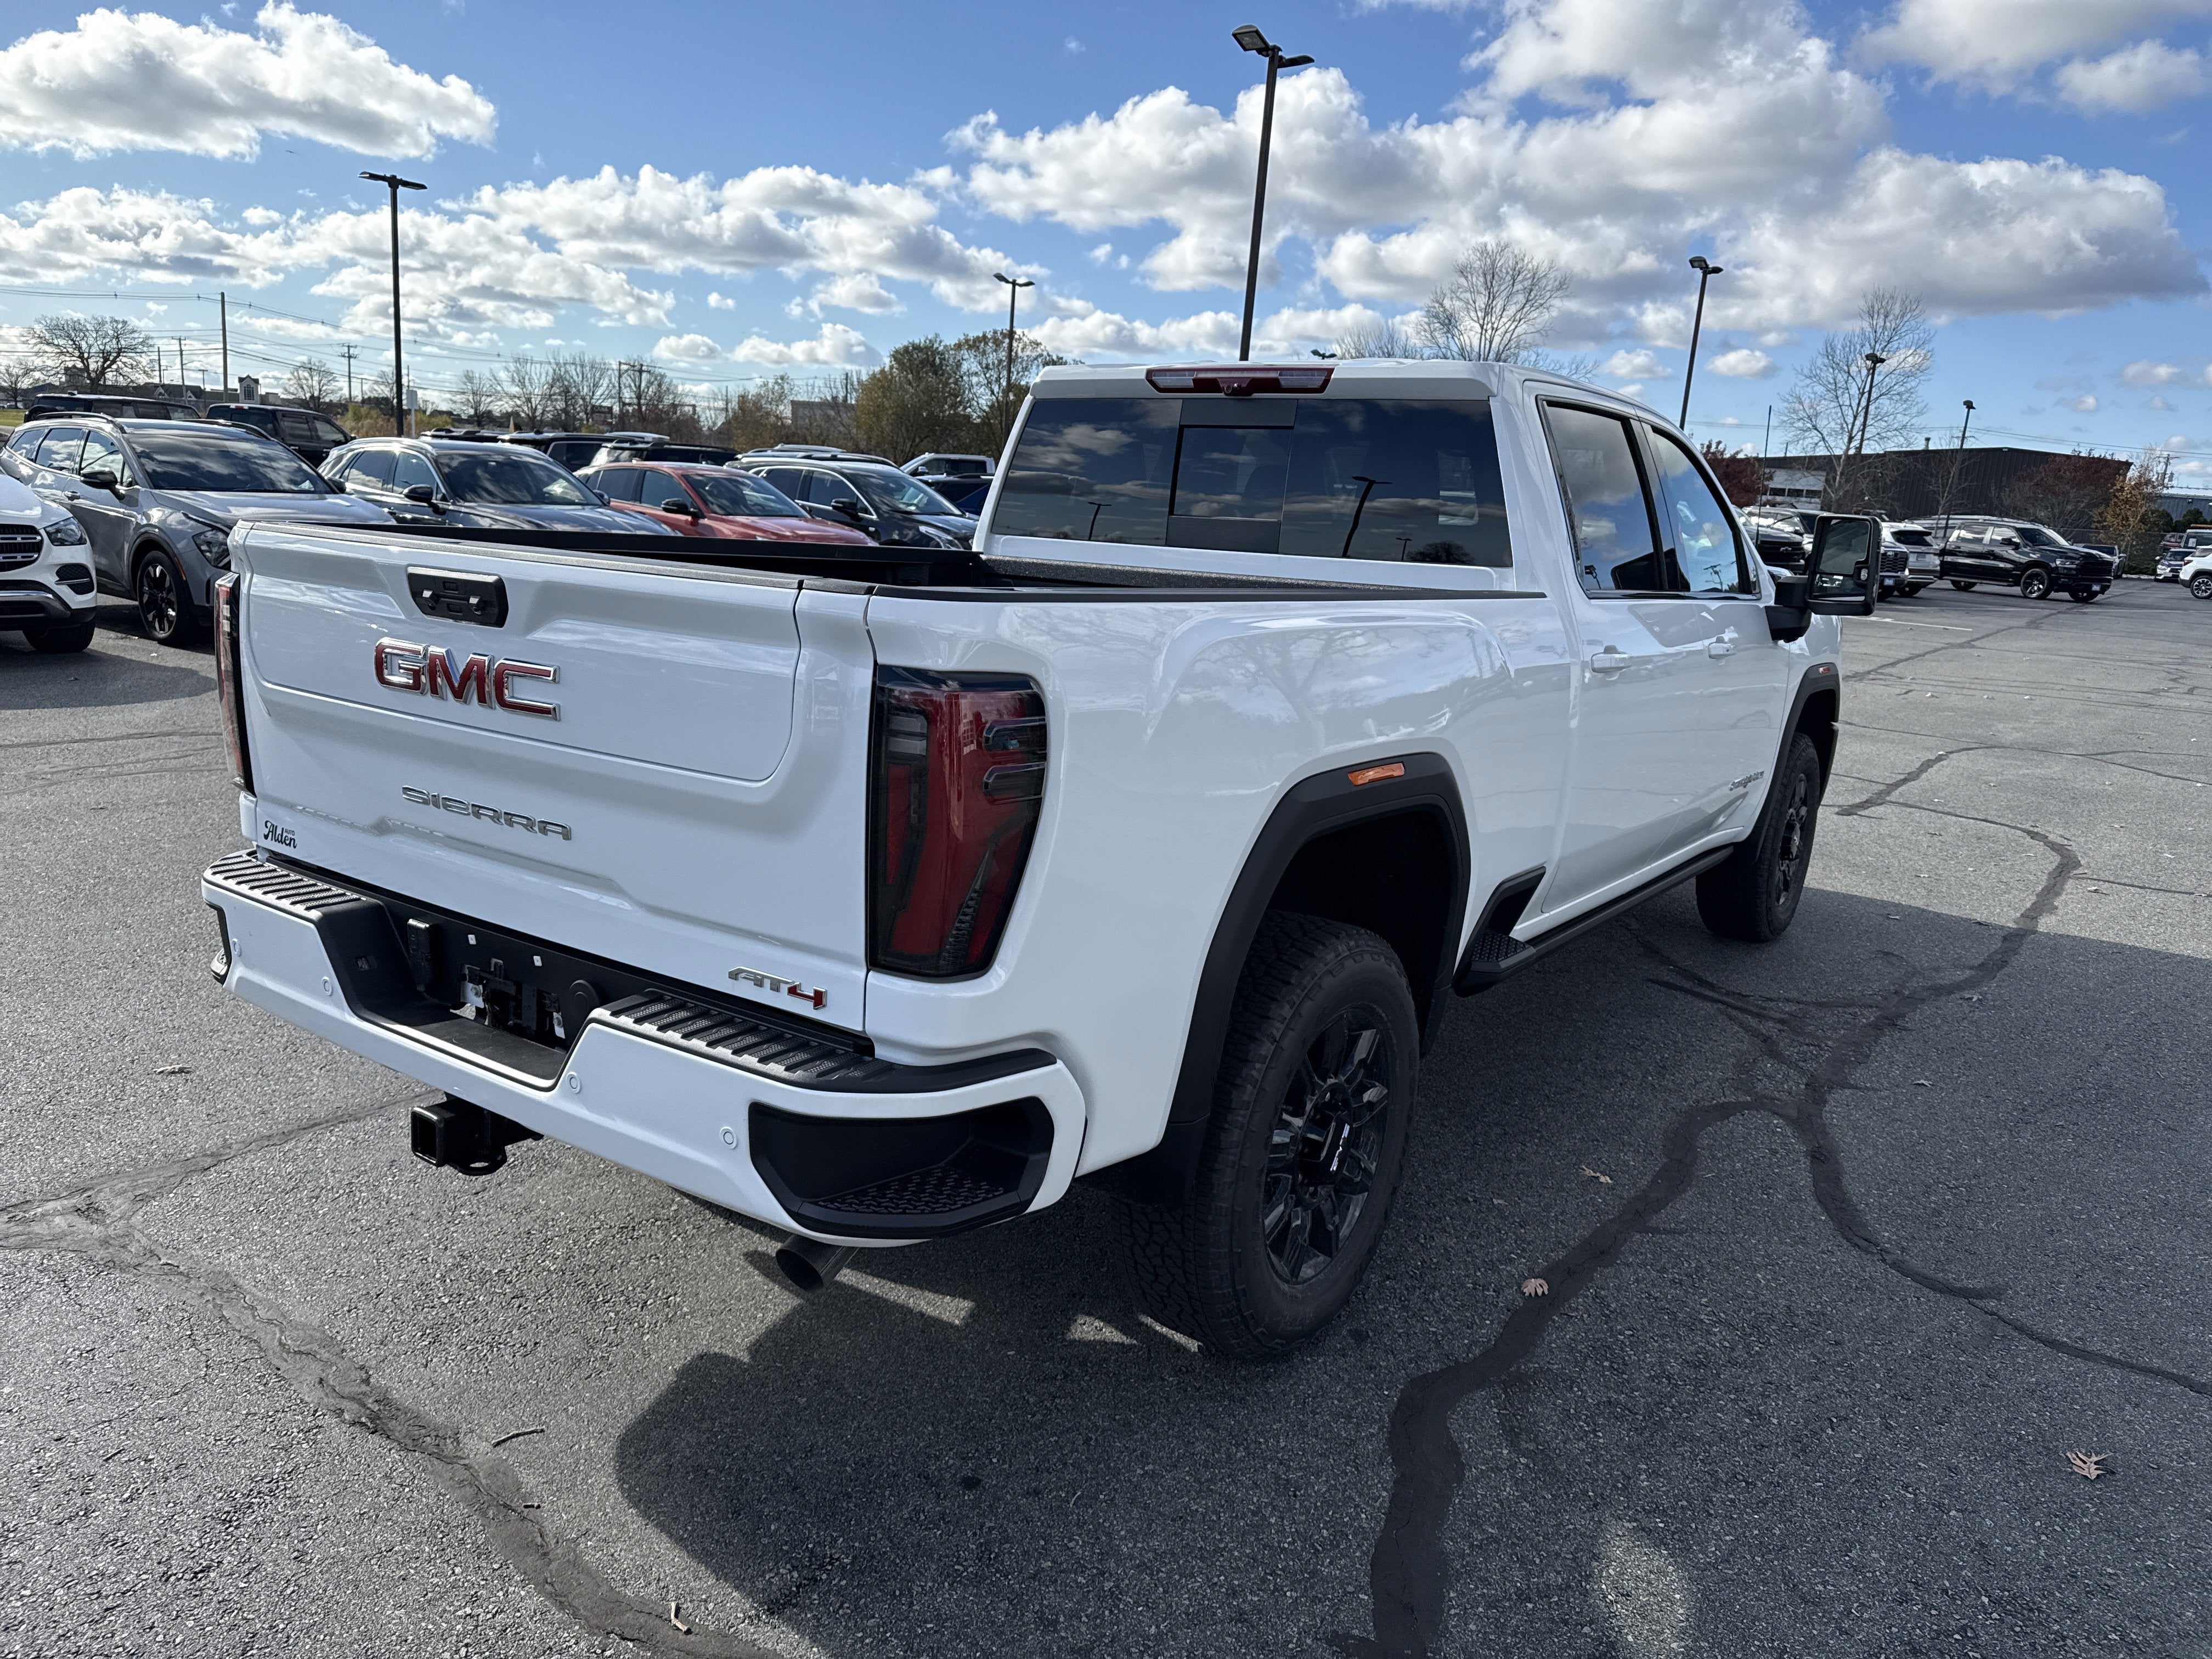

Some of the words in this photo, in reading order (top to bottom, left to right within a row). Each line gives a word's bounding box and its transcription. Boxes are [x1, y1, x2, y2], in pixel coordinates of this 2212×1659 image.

[375, 637, 561, 721] GMC
[263, 820, 297, 849] Alden
[402, 785, 572, 840] SIERRA
[728, 966, 827, 1010] AT4
